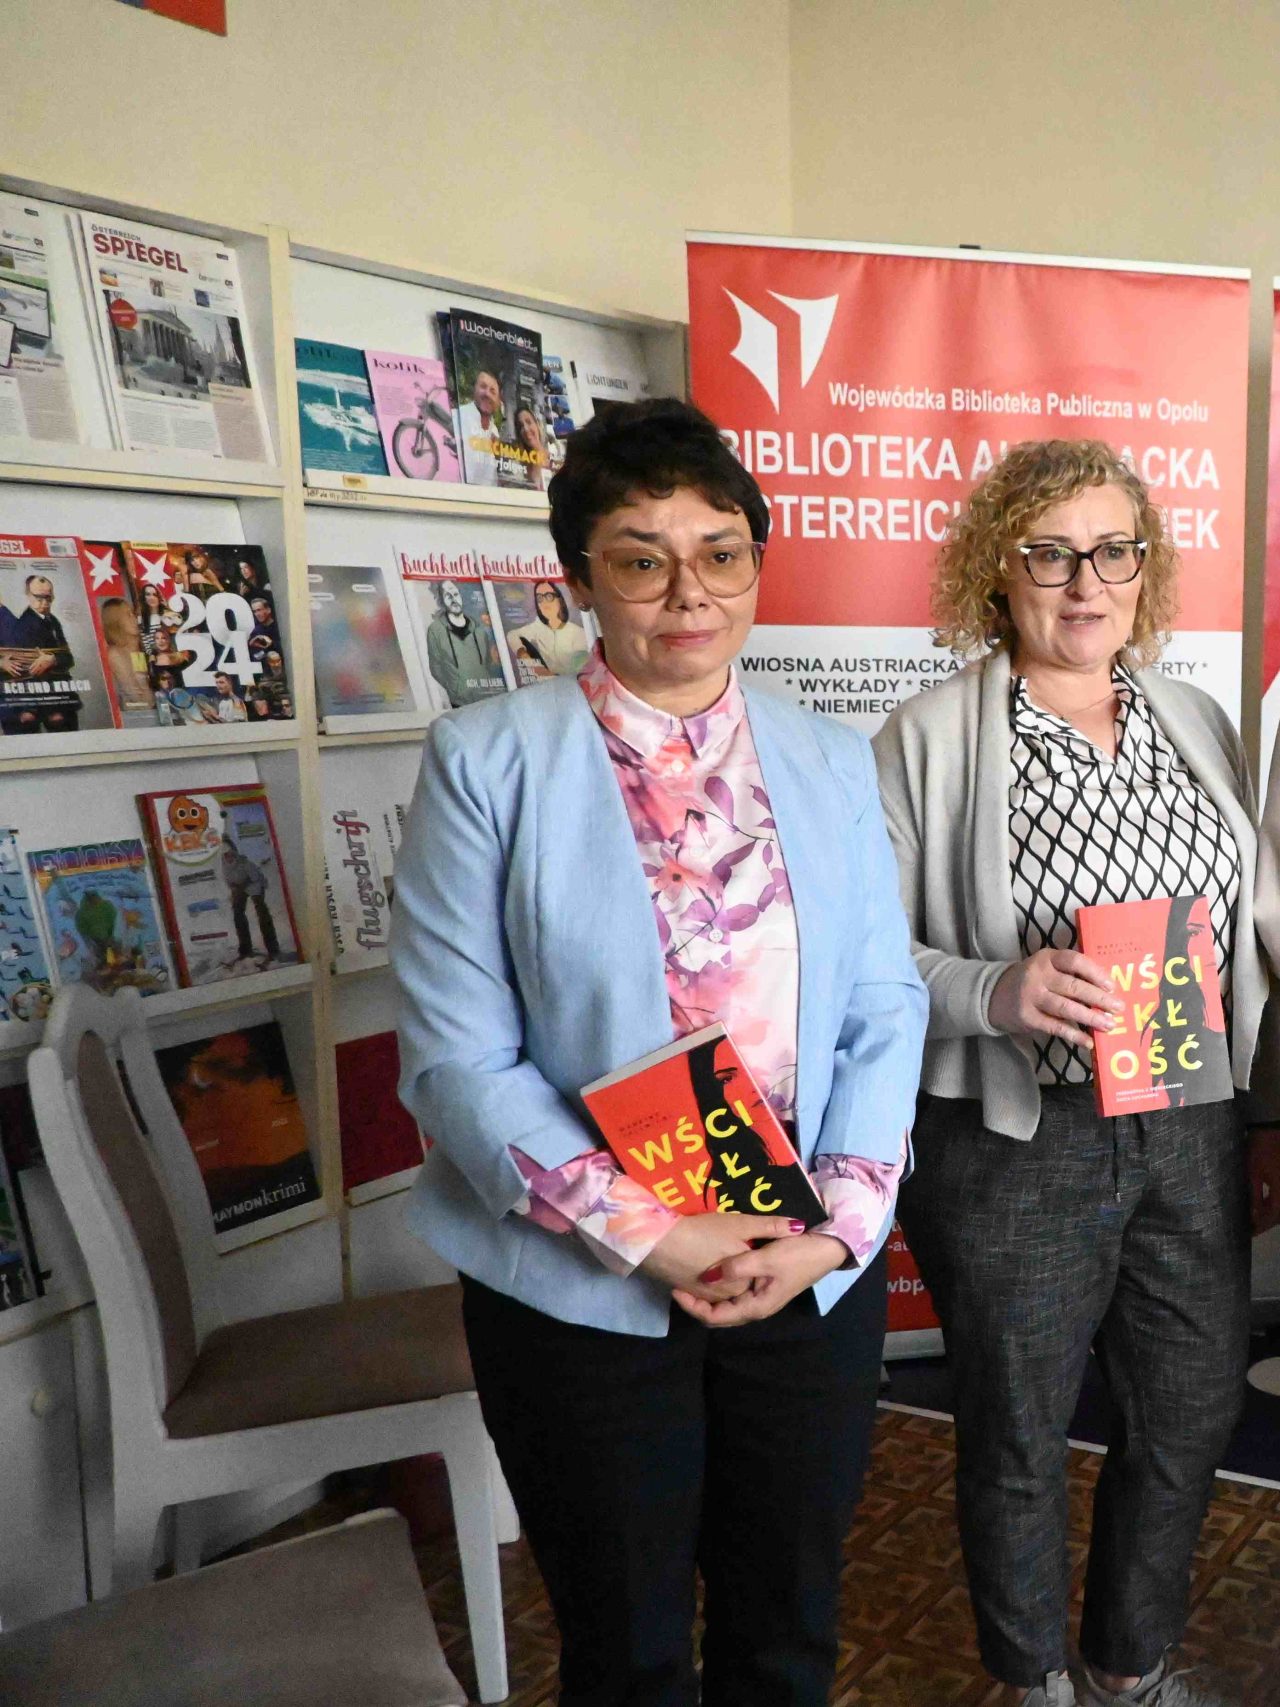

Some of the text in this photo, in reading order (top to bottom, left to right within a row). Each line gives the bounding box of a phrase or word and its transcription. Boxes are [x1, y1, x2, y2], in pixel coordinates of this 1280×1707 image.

[93, 233, 189, 274] SPIEGEL
[373, 358, 425, 374] kolik
[828, 382, 1209, 424] Wojewódzka Biblioteka Publiczna w Opolu
[741, 657, 960, 673] WIOSNA AUSTRIACKA
[799, 679, 900, 693] WYKŁADY
[813, 699, 900, 714] NIEMIEC
[1110, 1033, 1204, 1081] OŚĆ
[628, 1099, 754, 1172] WŚCI
[652, 1151, 751, 1209] EKŁ
